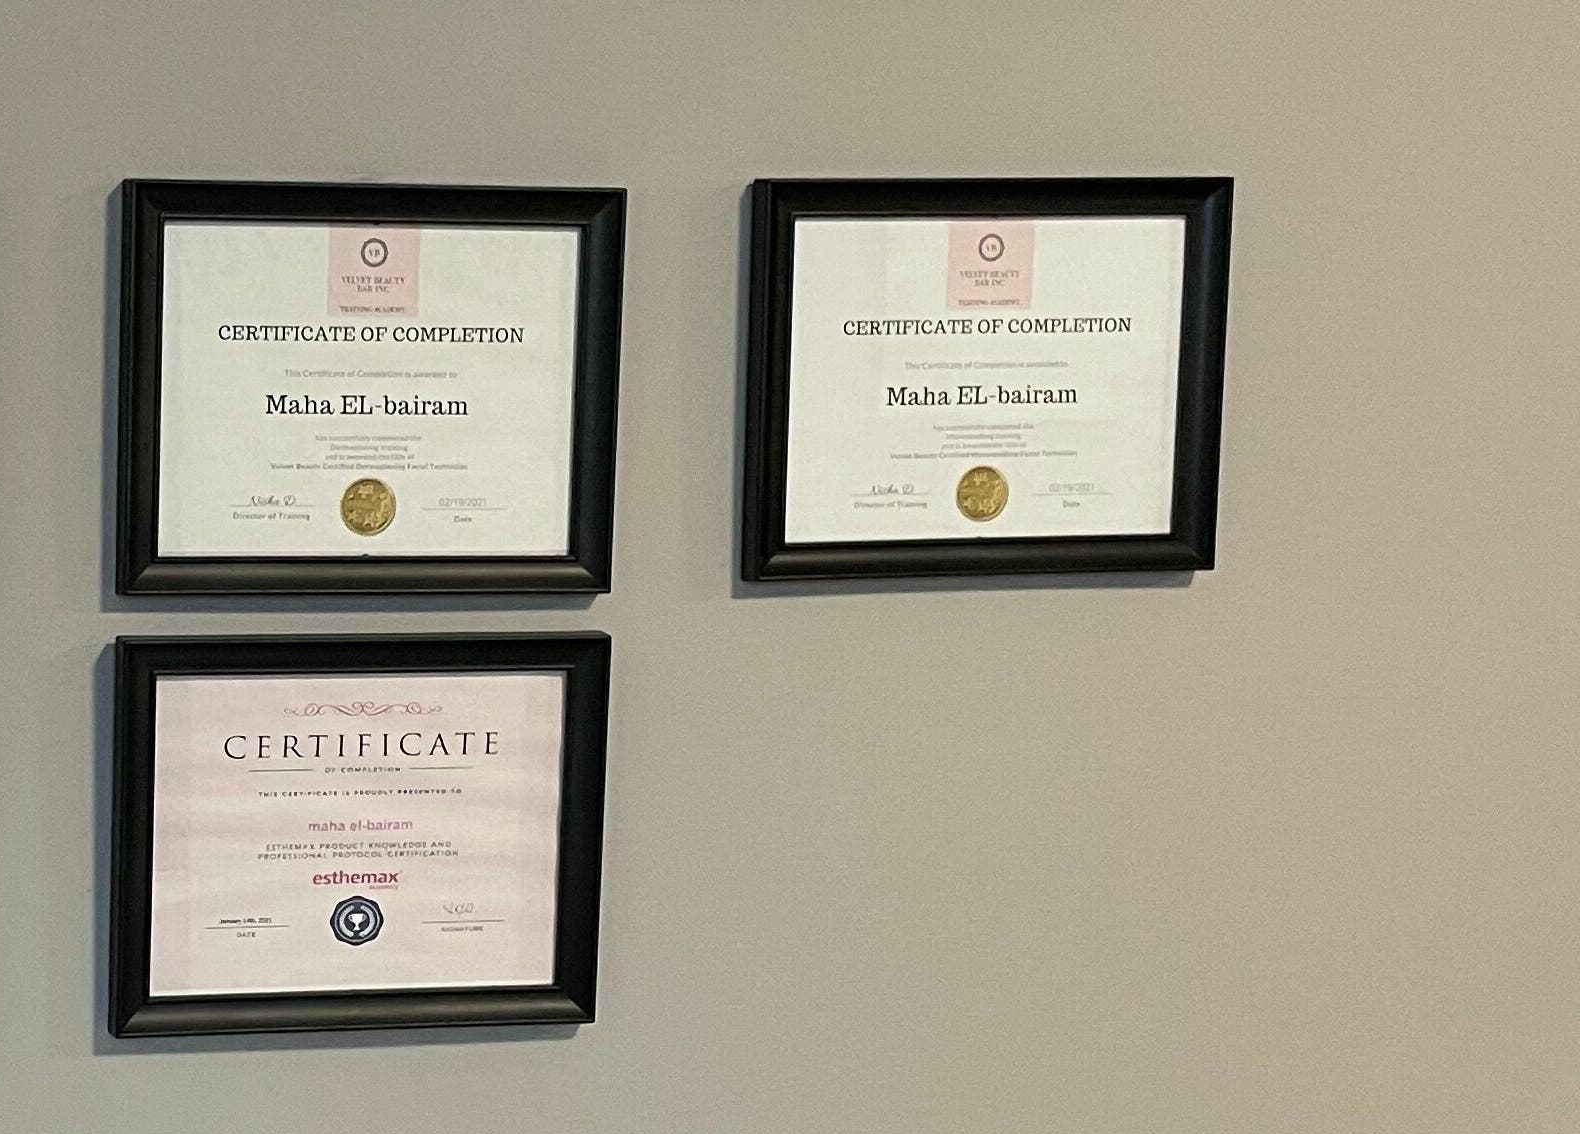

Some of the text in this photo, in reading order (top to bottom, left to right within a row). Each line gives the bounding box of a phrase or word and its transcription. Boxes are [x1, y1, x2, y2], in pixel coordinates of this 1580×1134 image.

[843, 317, 1132, 336] CERTIFICATE OF COMPLETION
[218, 325, 525, 344] CERTIFICATE OF COMPLETION
[886, 385, 1078, 406] Maha EL-bairam
[265, 395, 468, 416] Maha EL-bairam
[232, 512, 311, 522] Director of Training
[453, 515, 473, 524] Date
[223, 731, 500, 760] CERTIFICATE
[281, 790, 338, 798] CERTIFICATE
[308, 818, 413, 833] maha el-bairam
[265, 840, 452, 852] ESTHEMAX PRODUCT KNOWLEDGE AND
[257, 849, 459, 861] PROFESSIONAL PROTOCOL CERTIFICATION
[313, 870, 399, 886] esthemax
